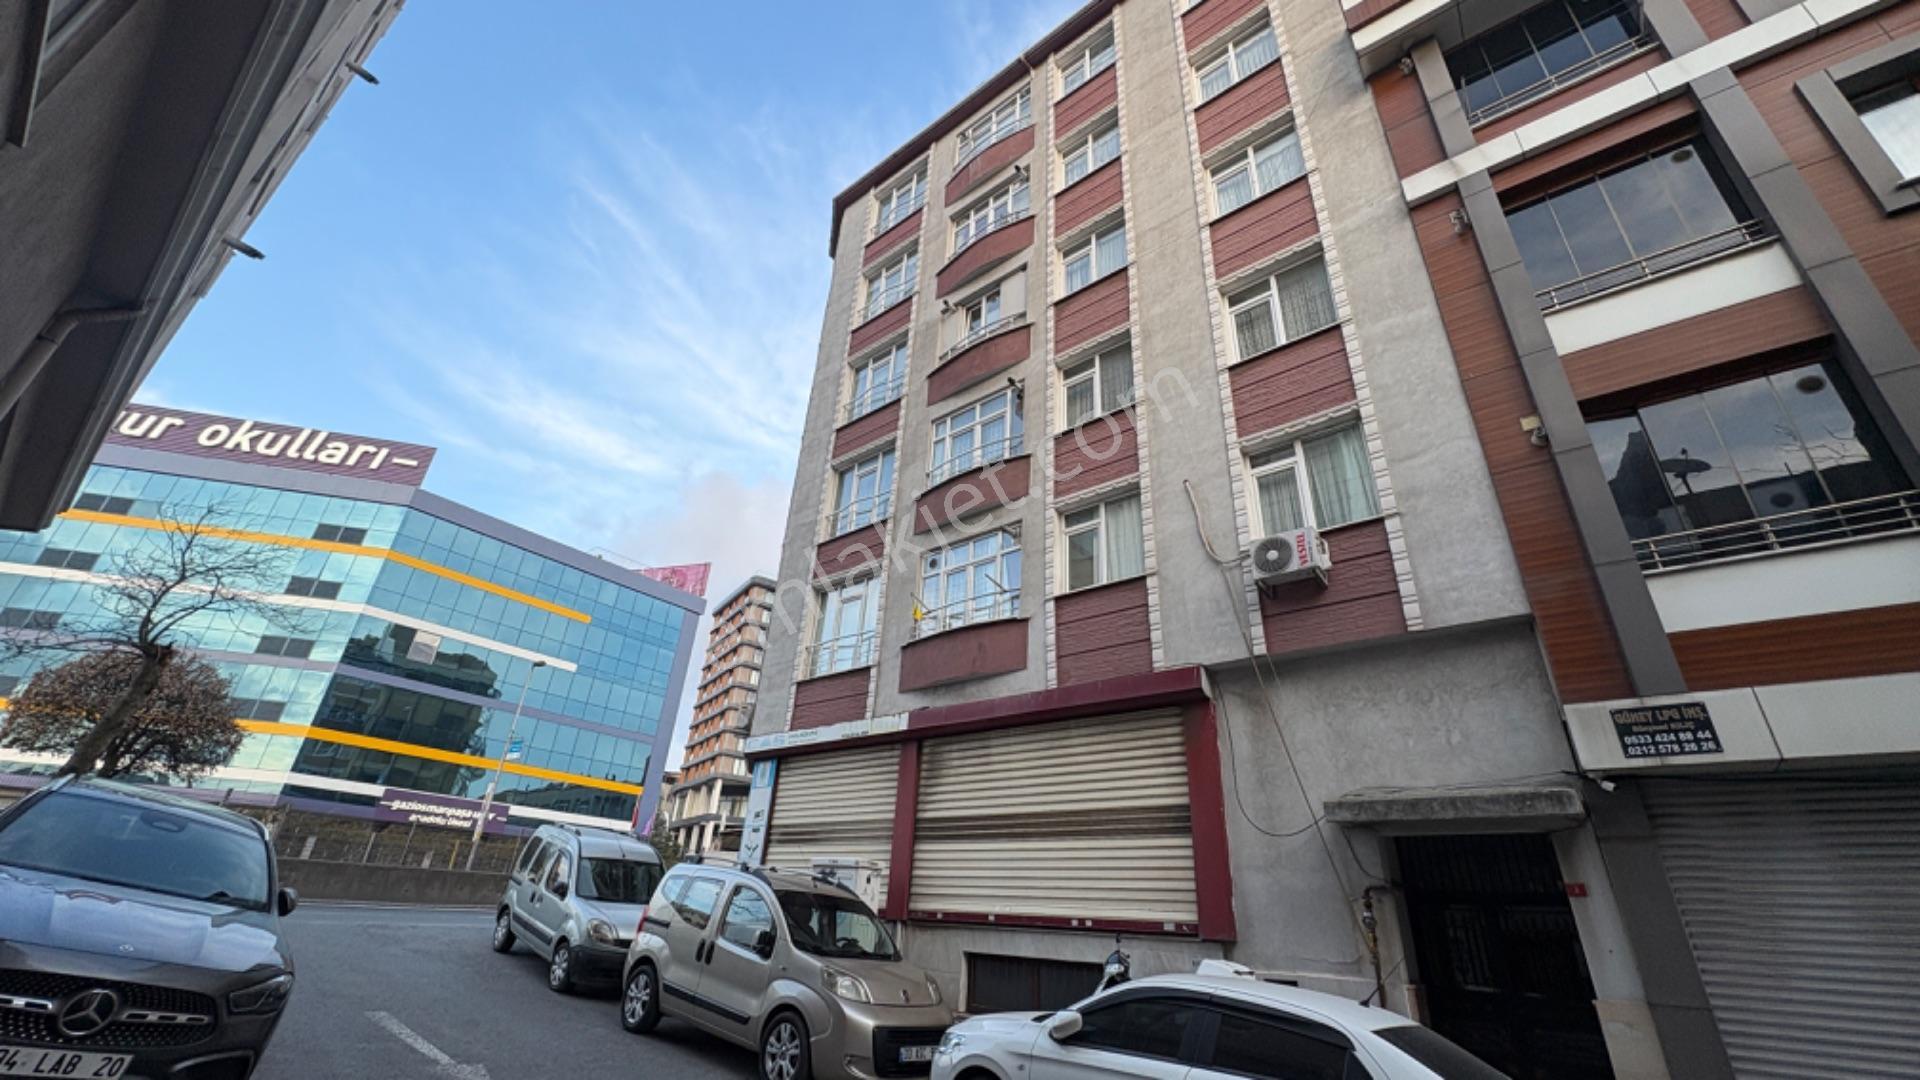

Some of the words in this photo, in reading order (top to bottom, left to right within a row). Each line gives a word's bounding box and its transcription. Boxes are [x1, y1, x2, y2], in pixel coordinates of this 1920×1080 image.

[112, 410, 184, 439] ur
[197, 420, 390, 471] okulları
[1655, 707, 1680, 722] LPG
[1624, 734, 1652, 744] 0533
[1697, 729, 1713, 739] 44
[1628, 745, 1656, 755] 0212
[32, 1052, 82, 1075] LAB
[92, 1056, 125, 1077] 20
